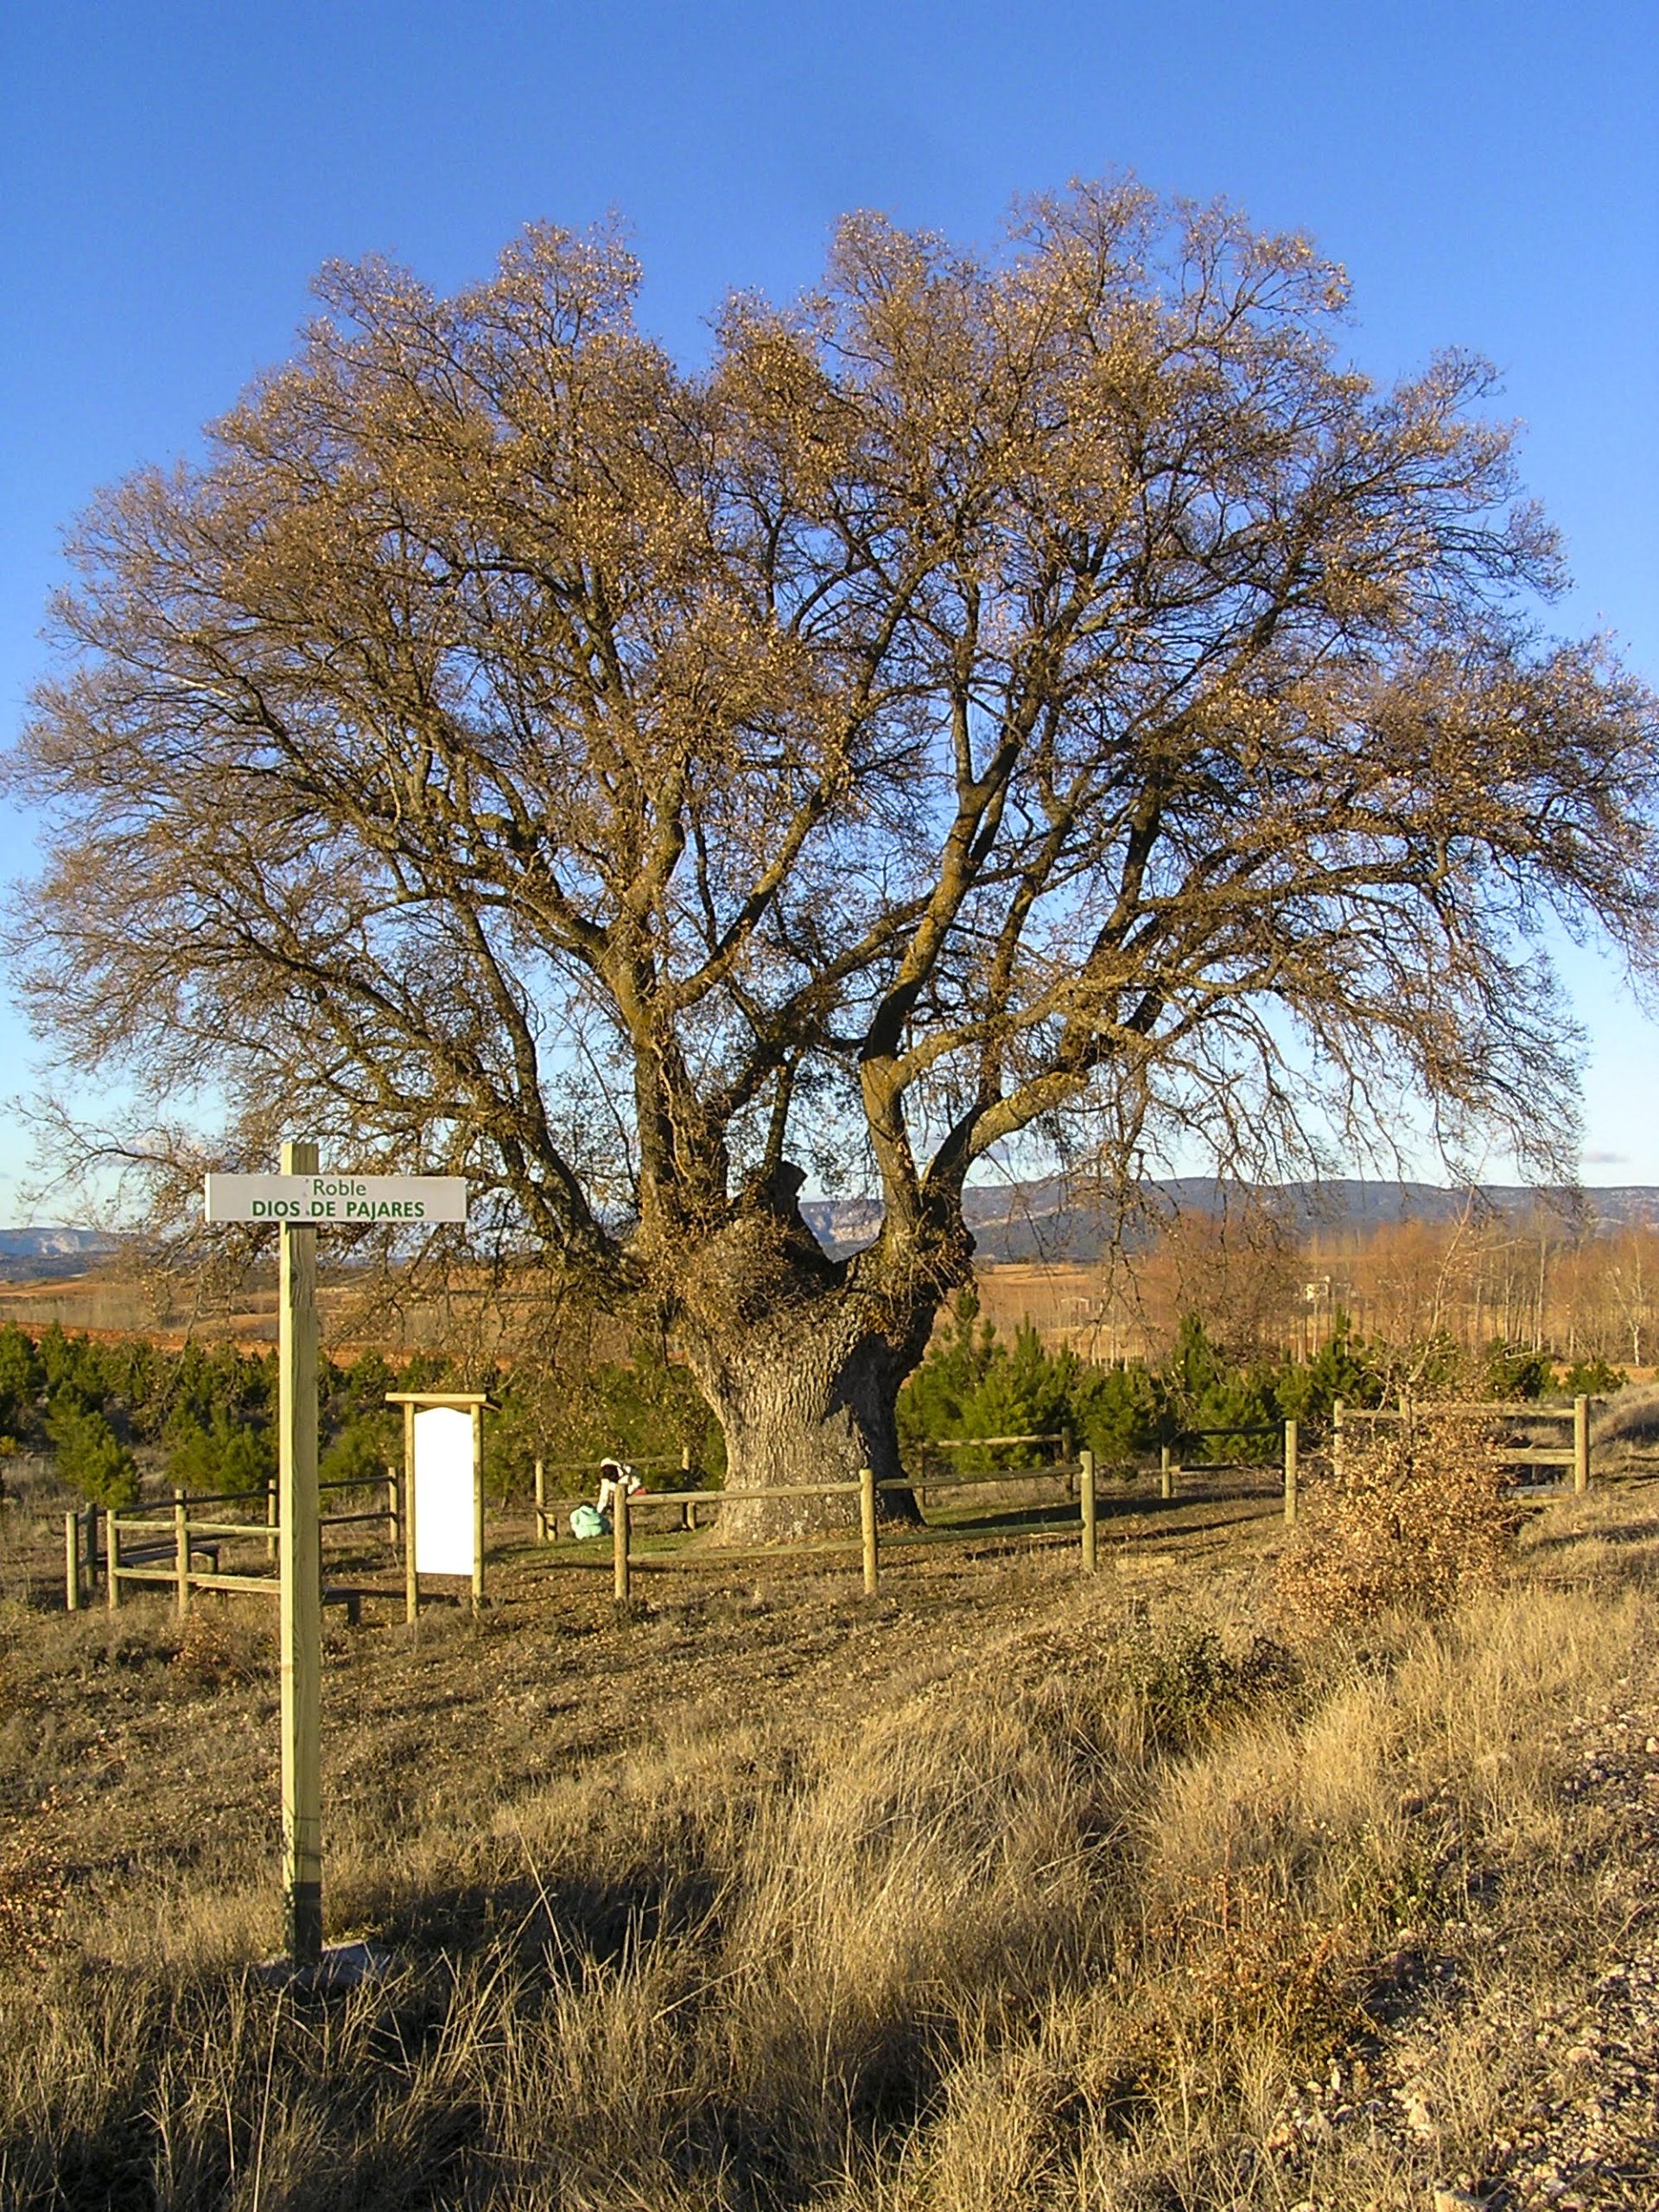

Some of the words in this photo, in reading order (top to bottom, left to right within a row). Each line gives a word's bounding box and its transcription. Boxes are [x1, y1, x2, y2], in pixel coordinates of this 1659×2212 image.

[313, 1179, 366, 1197] Roble
[251, 1200, 300, 1217] DIOS
[311, 1201, 336, 1217] DE
[346, 1201, 425, 1220] PAJARES
